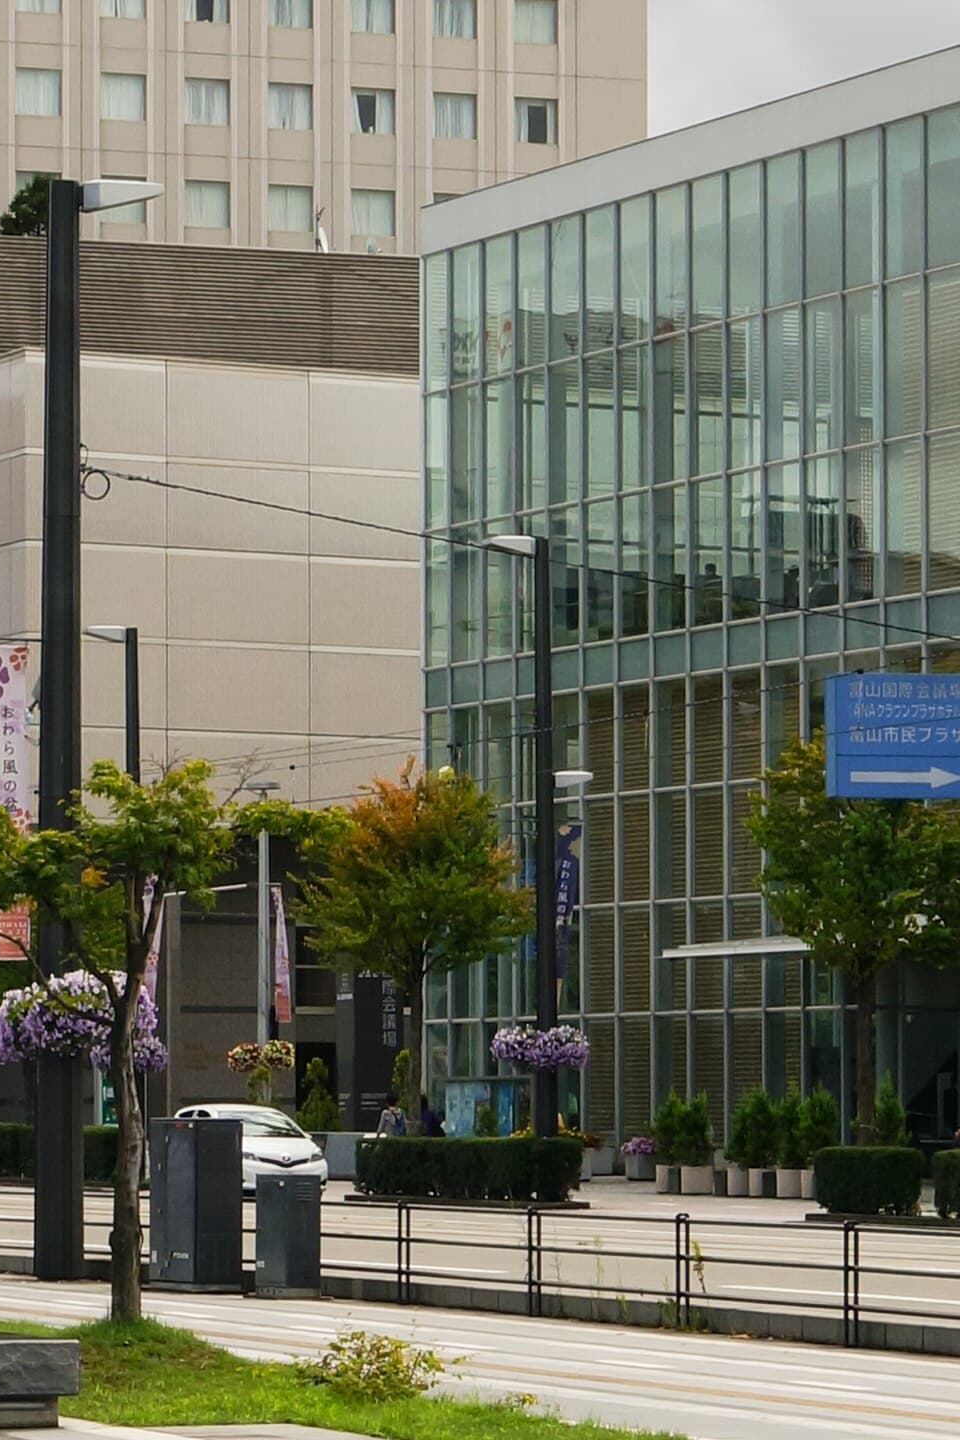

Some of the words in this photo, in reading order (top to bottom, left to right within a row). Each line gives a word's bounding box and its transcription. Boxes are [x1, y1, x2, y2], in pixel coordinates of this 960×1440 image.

[2, 705, 18, 812] おわら風の盆
